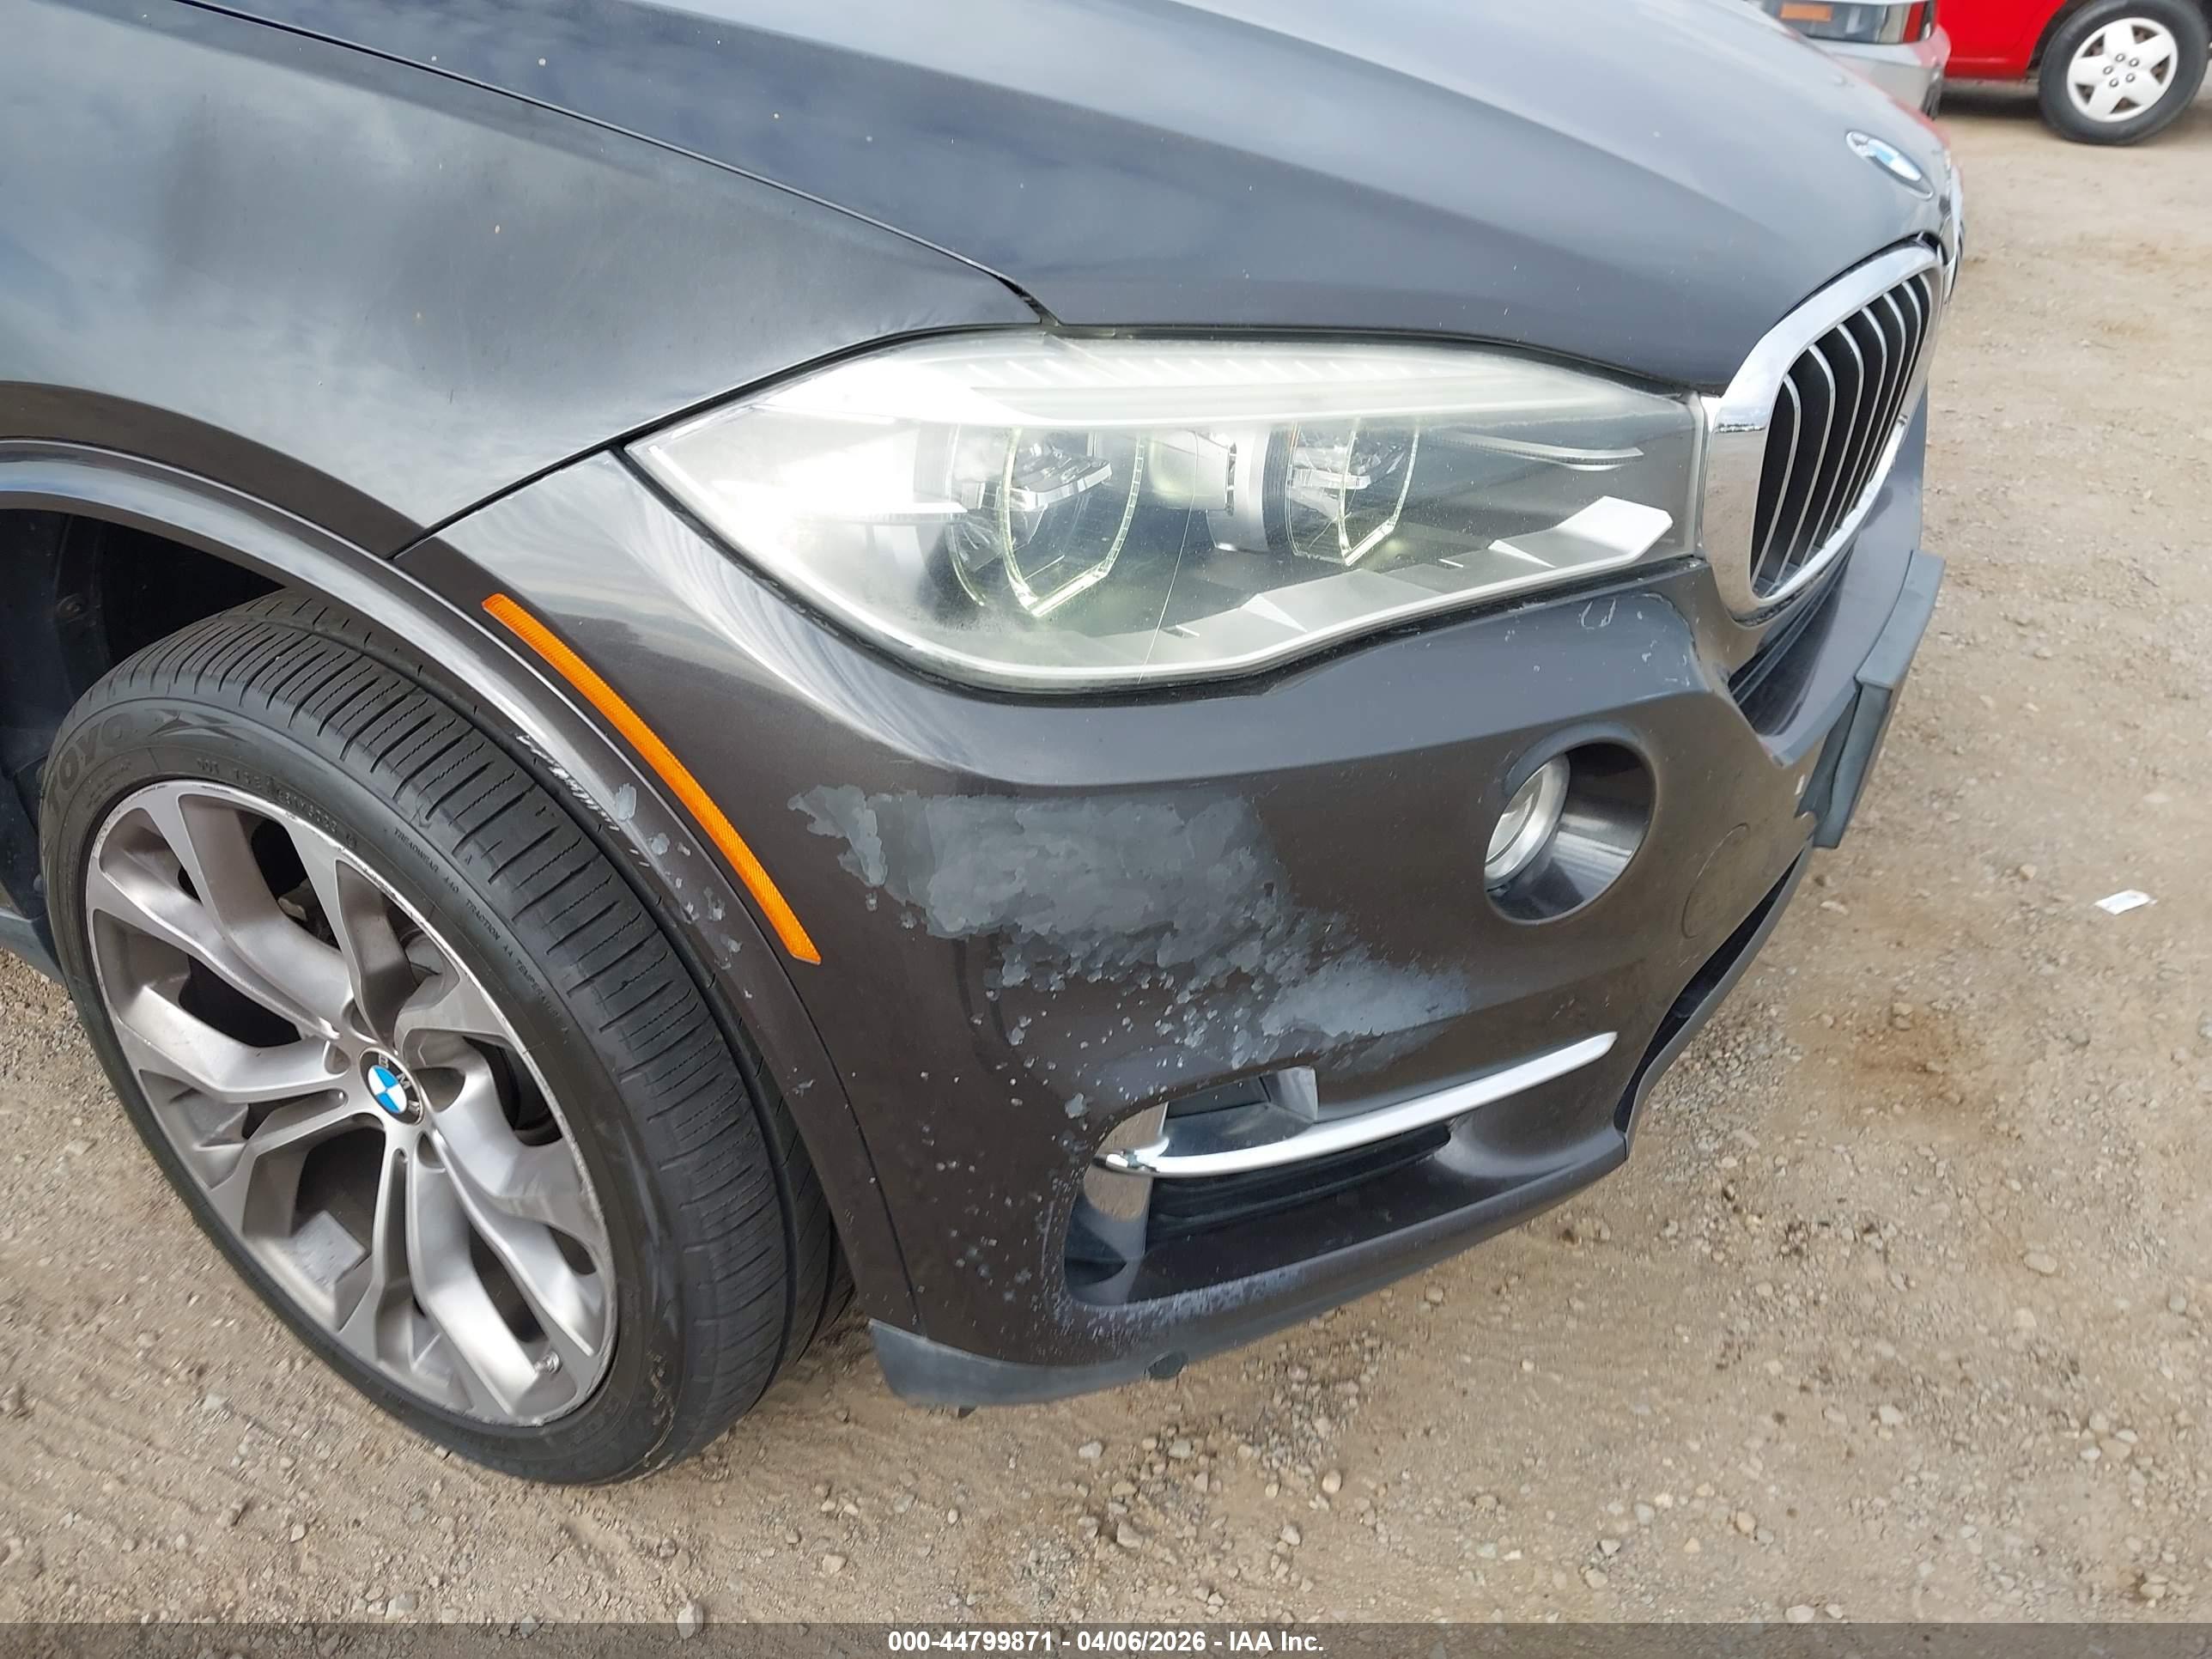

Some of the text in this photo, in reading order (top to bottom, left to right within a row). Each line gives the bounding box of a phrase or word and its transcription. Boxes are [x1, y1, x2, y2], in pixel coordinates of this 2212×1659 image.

[393, 827, 440, 873] TREADWEAR
[464, 899, 501, 940] TRACTION
[378, 1053, 421, 1114] BMW
